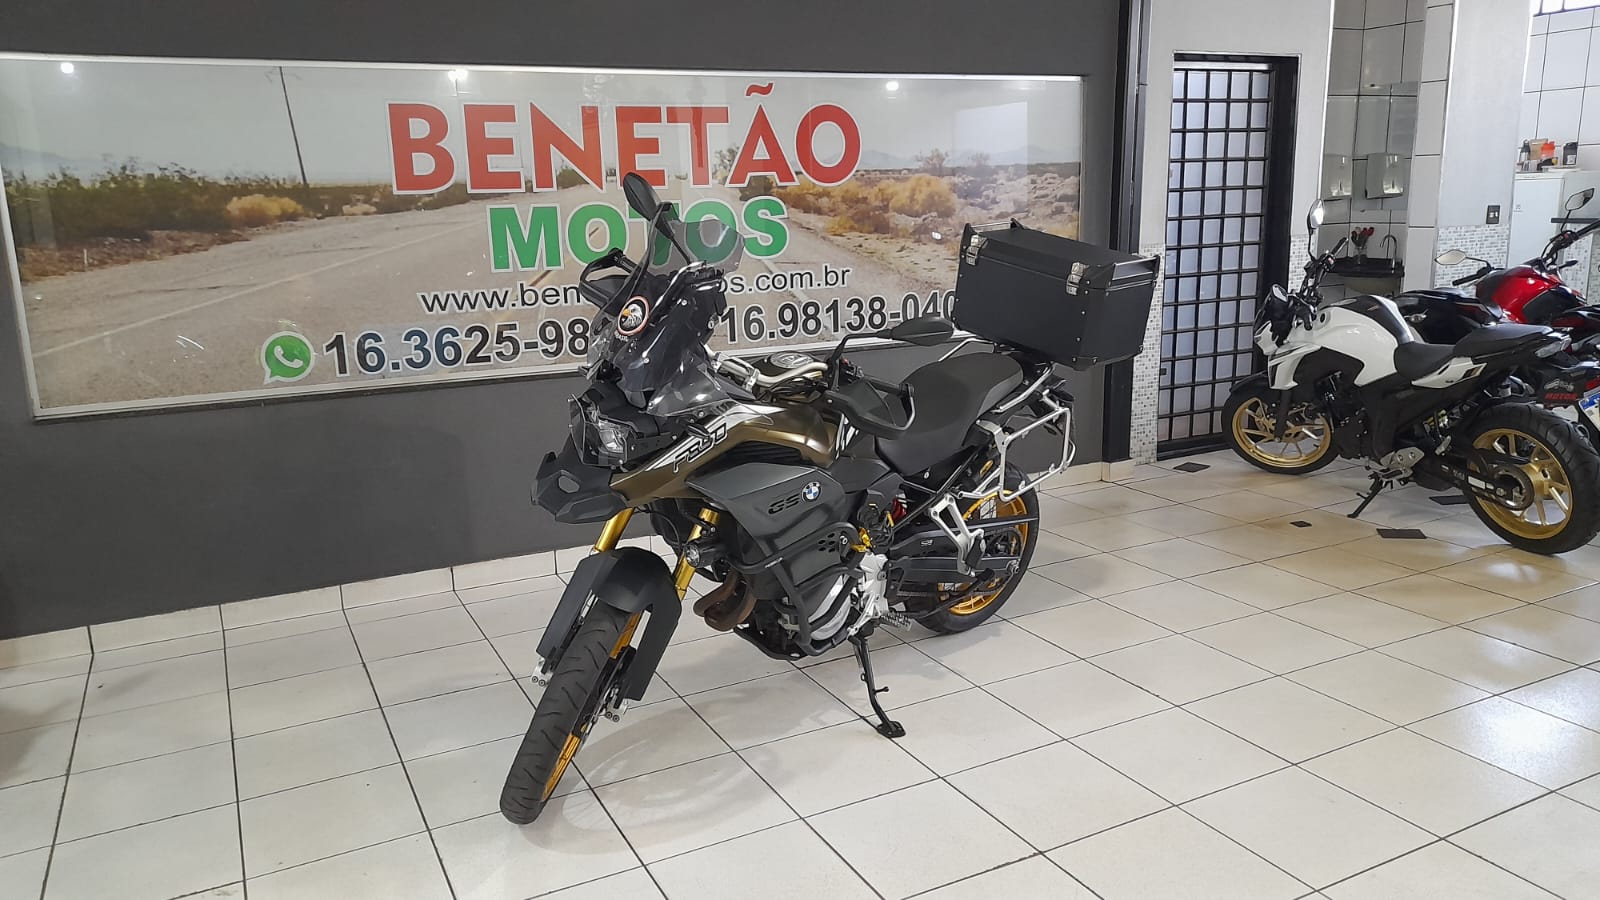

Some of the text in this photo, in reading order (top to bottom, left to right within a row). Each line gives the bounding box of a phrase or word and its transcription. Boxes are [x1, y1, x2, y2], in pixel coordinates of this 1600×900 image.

[387, 82, 862, 193] BENETÃO
[488, 196, 789, 270] MOTOS
[767, 493, 801, 515] GS
